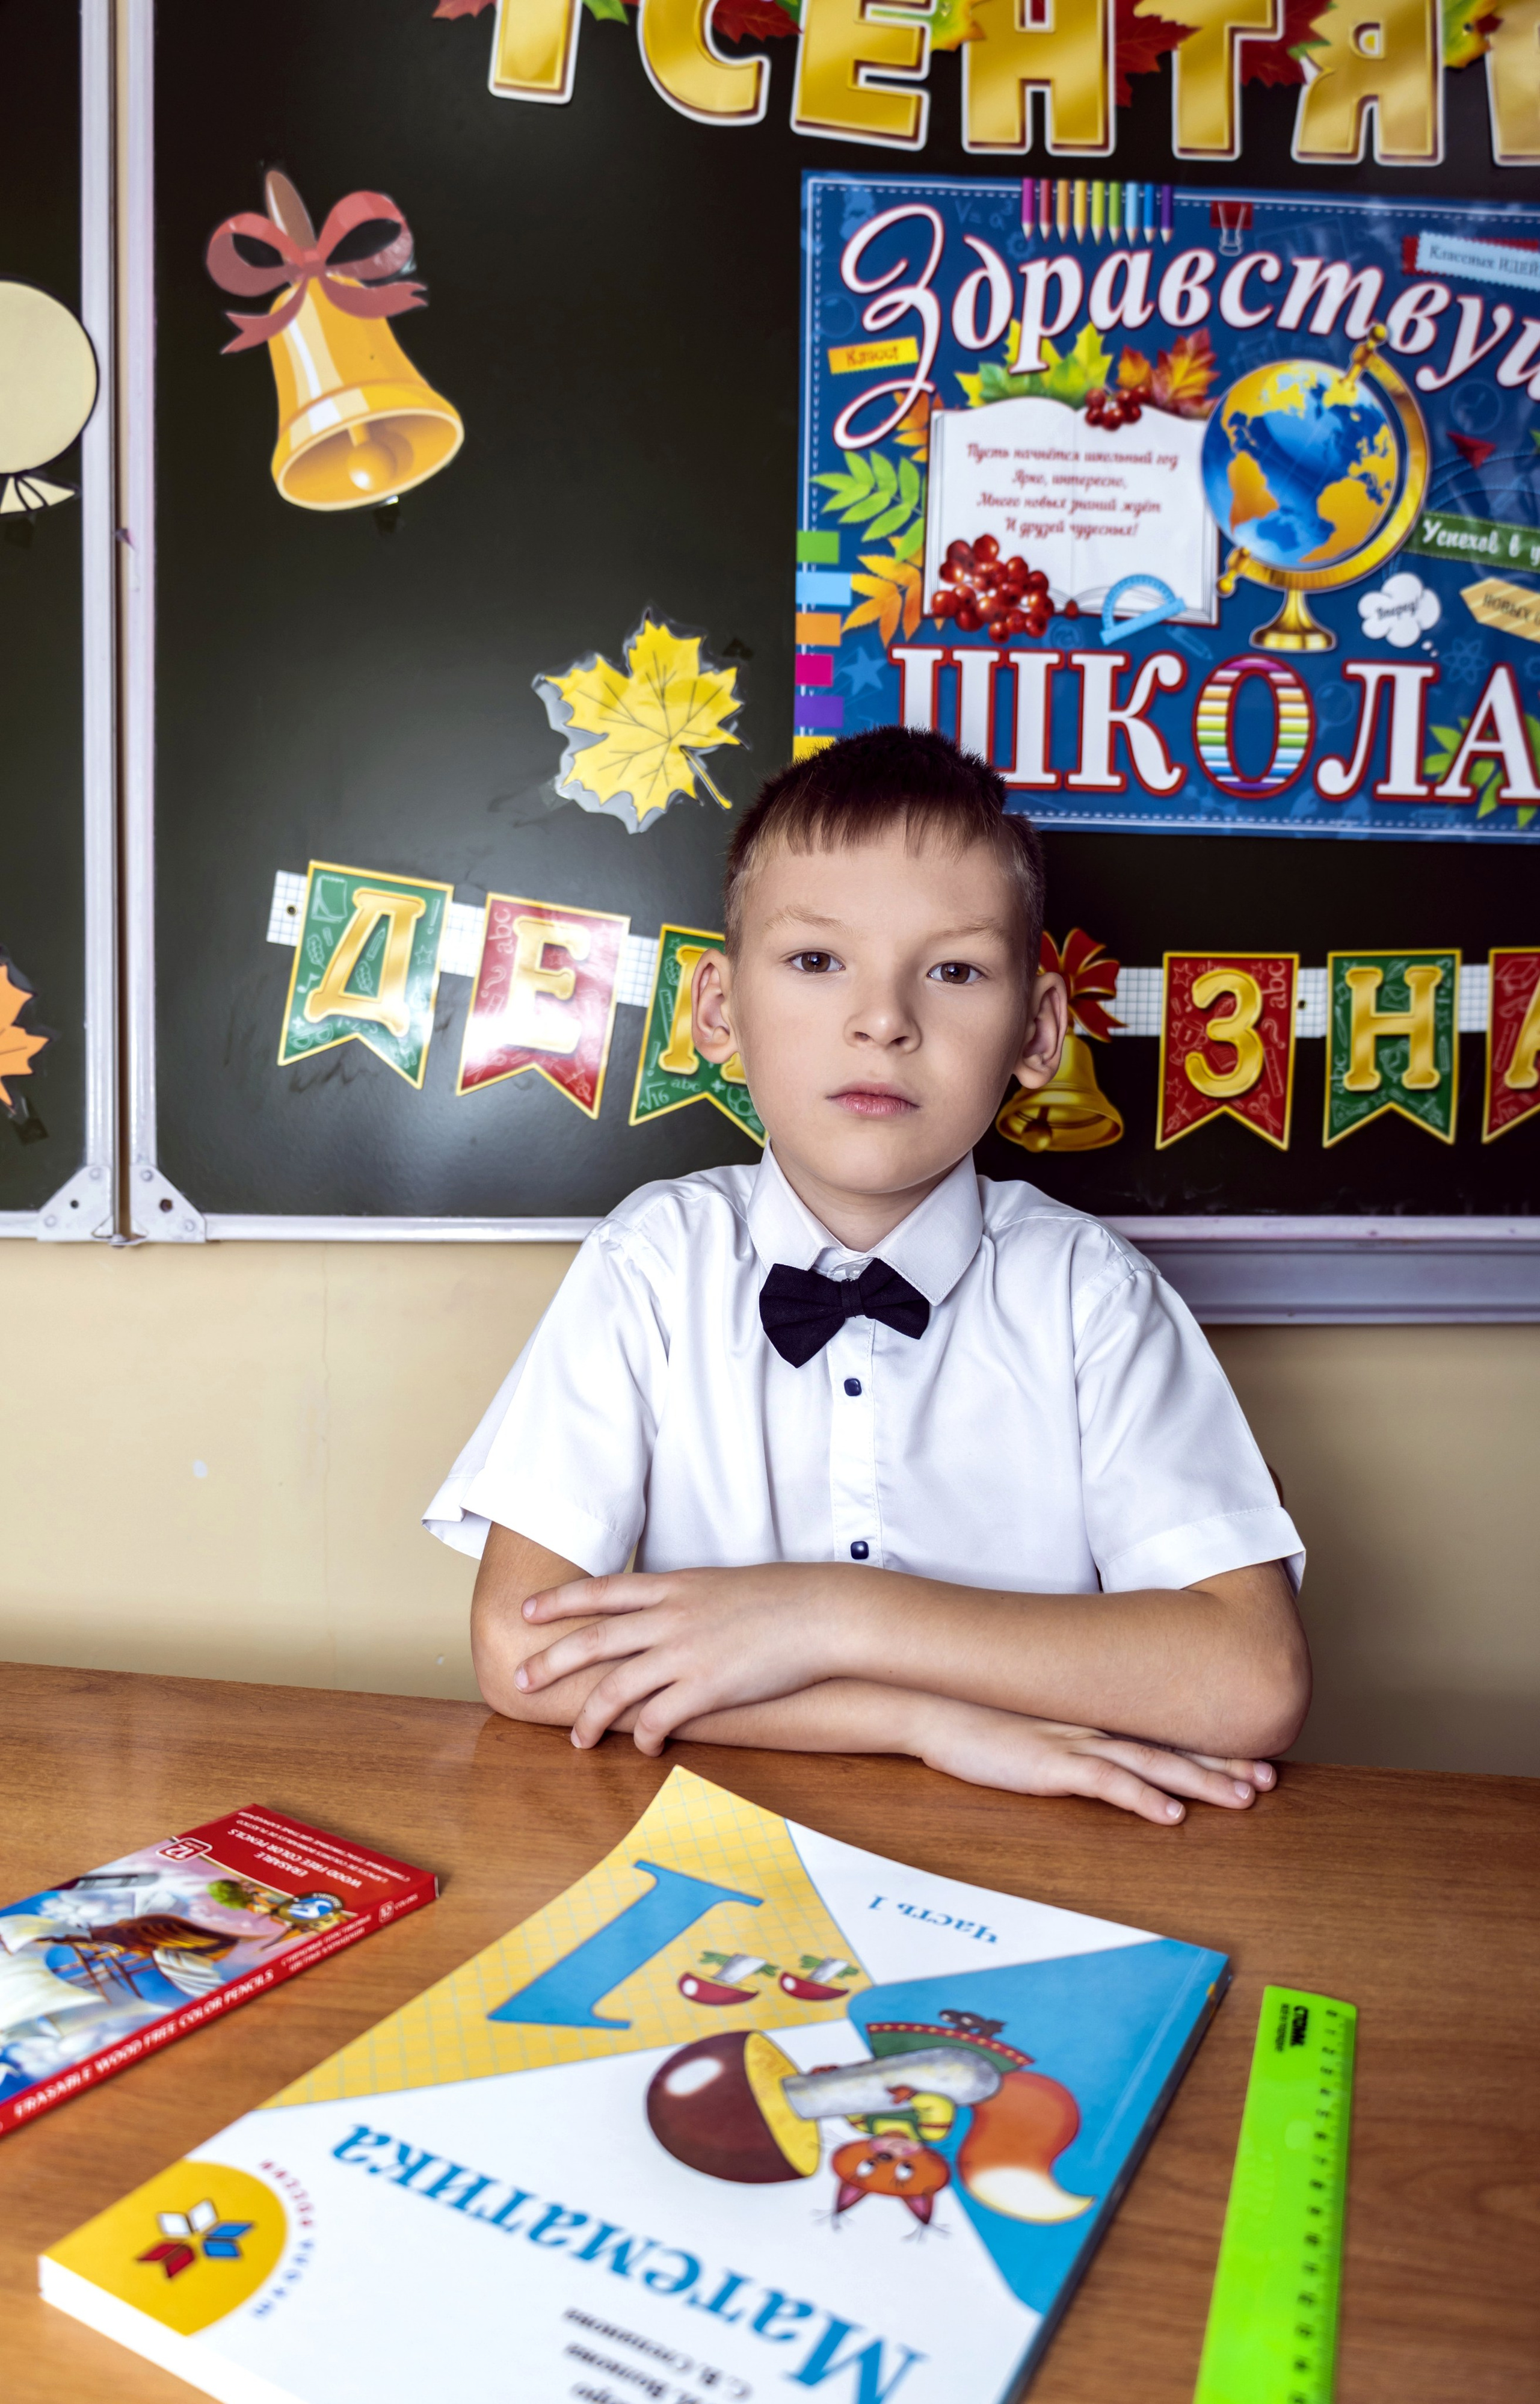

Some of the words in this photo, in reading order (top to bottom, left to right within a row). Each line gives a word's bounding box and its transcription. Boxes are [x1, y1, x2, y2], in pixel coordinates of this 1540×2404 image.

[636, 0, 1540, 166] СЕНТЯ
[966, 443, 1009, 464] Пусть
[1084, 449, 1153, 466] школьный
[1156, 453, 1179, 471] год
[976, 492, 1021, 509] Много
[1024, 495, 1066, 510] новых
[1005, 516, 1017, 532] И
[1020, 519, 1065, 540] друзей
[1422, 518, 1500, 555] Успехов
[227, 1828, 270, 1848] PENCILS
[165, 1844, 195, 1859] 12
[266, 1843, 303, 1862] COLOR
[253, 1851, 309, 1878] ERASABLE
[299, 1857, 330, 1873] FREE
[325, 1869, 363, 1888] WOOD
[868, 1894, 889, 1910] 1
[897, 1902, 998, 1944] Часть
[485, 1859, 765, 2030] 1
[13, 2064, 93, 2119] ERASABLE
[94, 2039, 143, 2073] WOOD
[143, 2019, 179, 2048] FREE
[179, 1996, 223, 2028] COLOR
[224, 1968, 274, 2005] PENCILS
[330, 2122, 929, 2404] Математика
